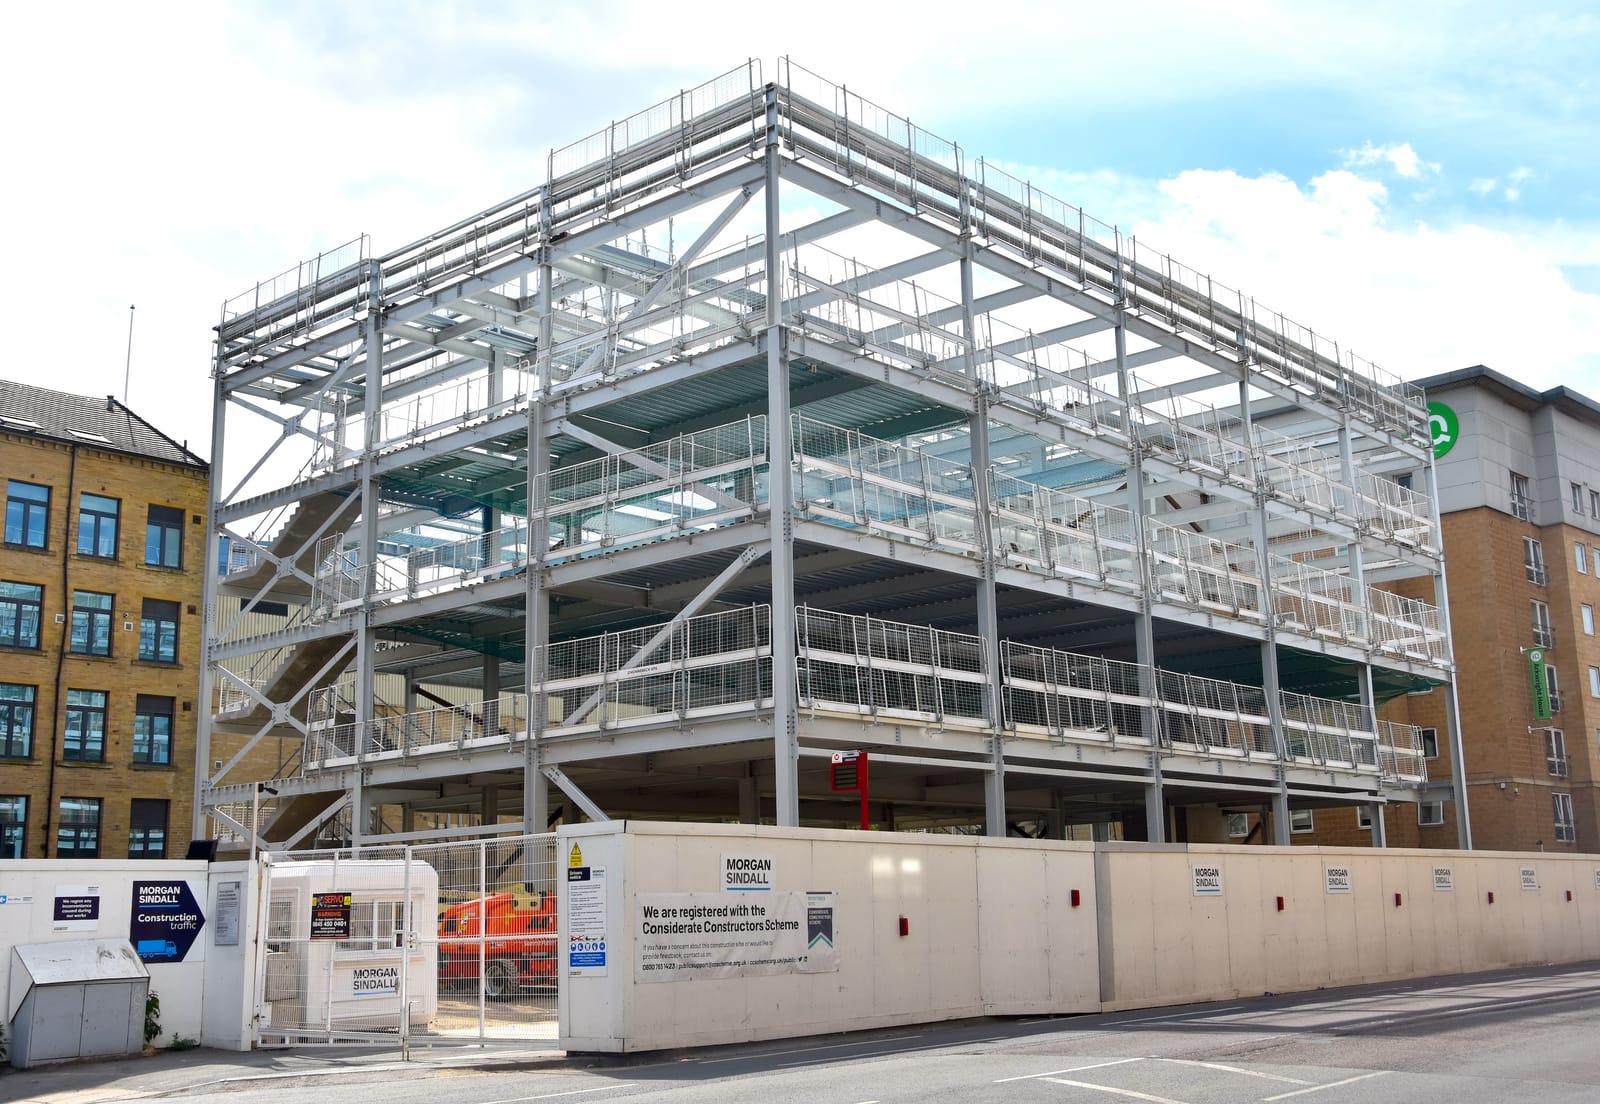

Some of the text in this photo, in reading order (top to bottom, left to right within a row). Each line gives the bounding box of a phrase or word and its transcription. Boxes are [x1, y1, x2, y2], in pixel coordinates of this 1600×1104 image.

[726, 859, 771, 871] MORGAN
[1196, 868, 1220, 877] MORGAN
[1328, 868, 1348, 877] MORGAN
[726, 872, 769, 884] SINDALL
[1196, 878, 1219, 887] SINDALL
[1328, 877, 1348, 886] SINDALL
[139, 886, 181, 895] MORGAN
[138, 895, 179, 904] SINDALL
[643, 904, 765, 920] We are registered with the
[137, 913, 197, 922] Construction
[170, 920, 197, 930] traffic
[642, 918, 799, 935] Considerate Constructors Scheme
[353, 967, 398, 979] MORGAN
[353, 979, 396, 990] SINDALL
